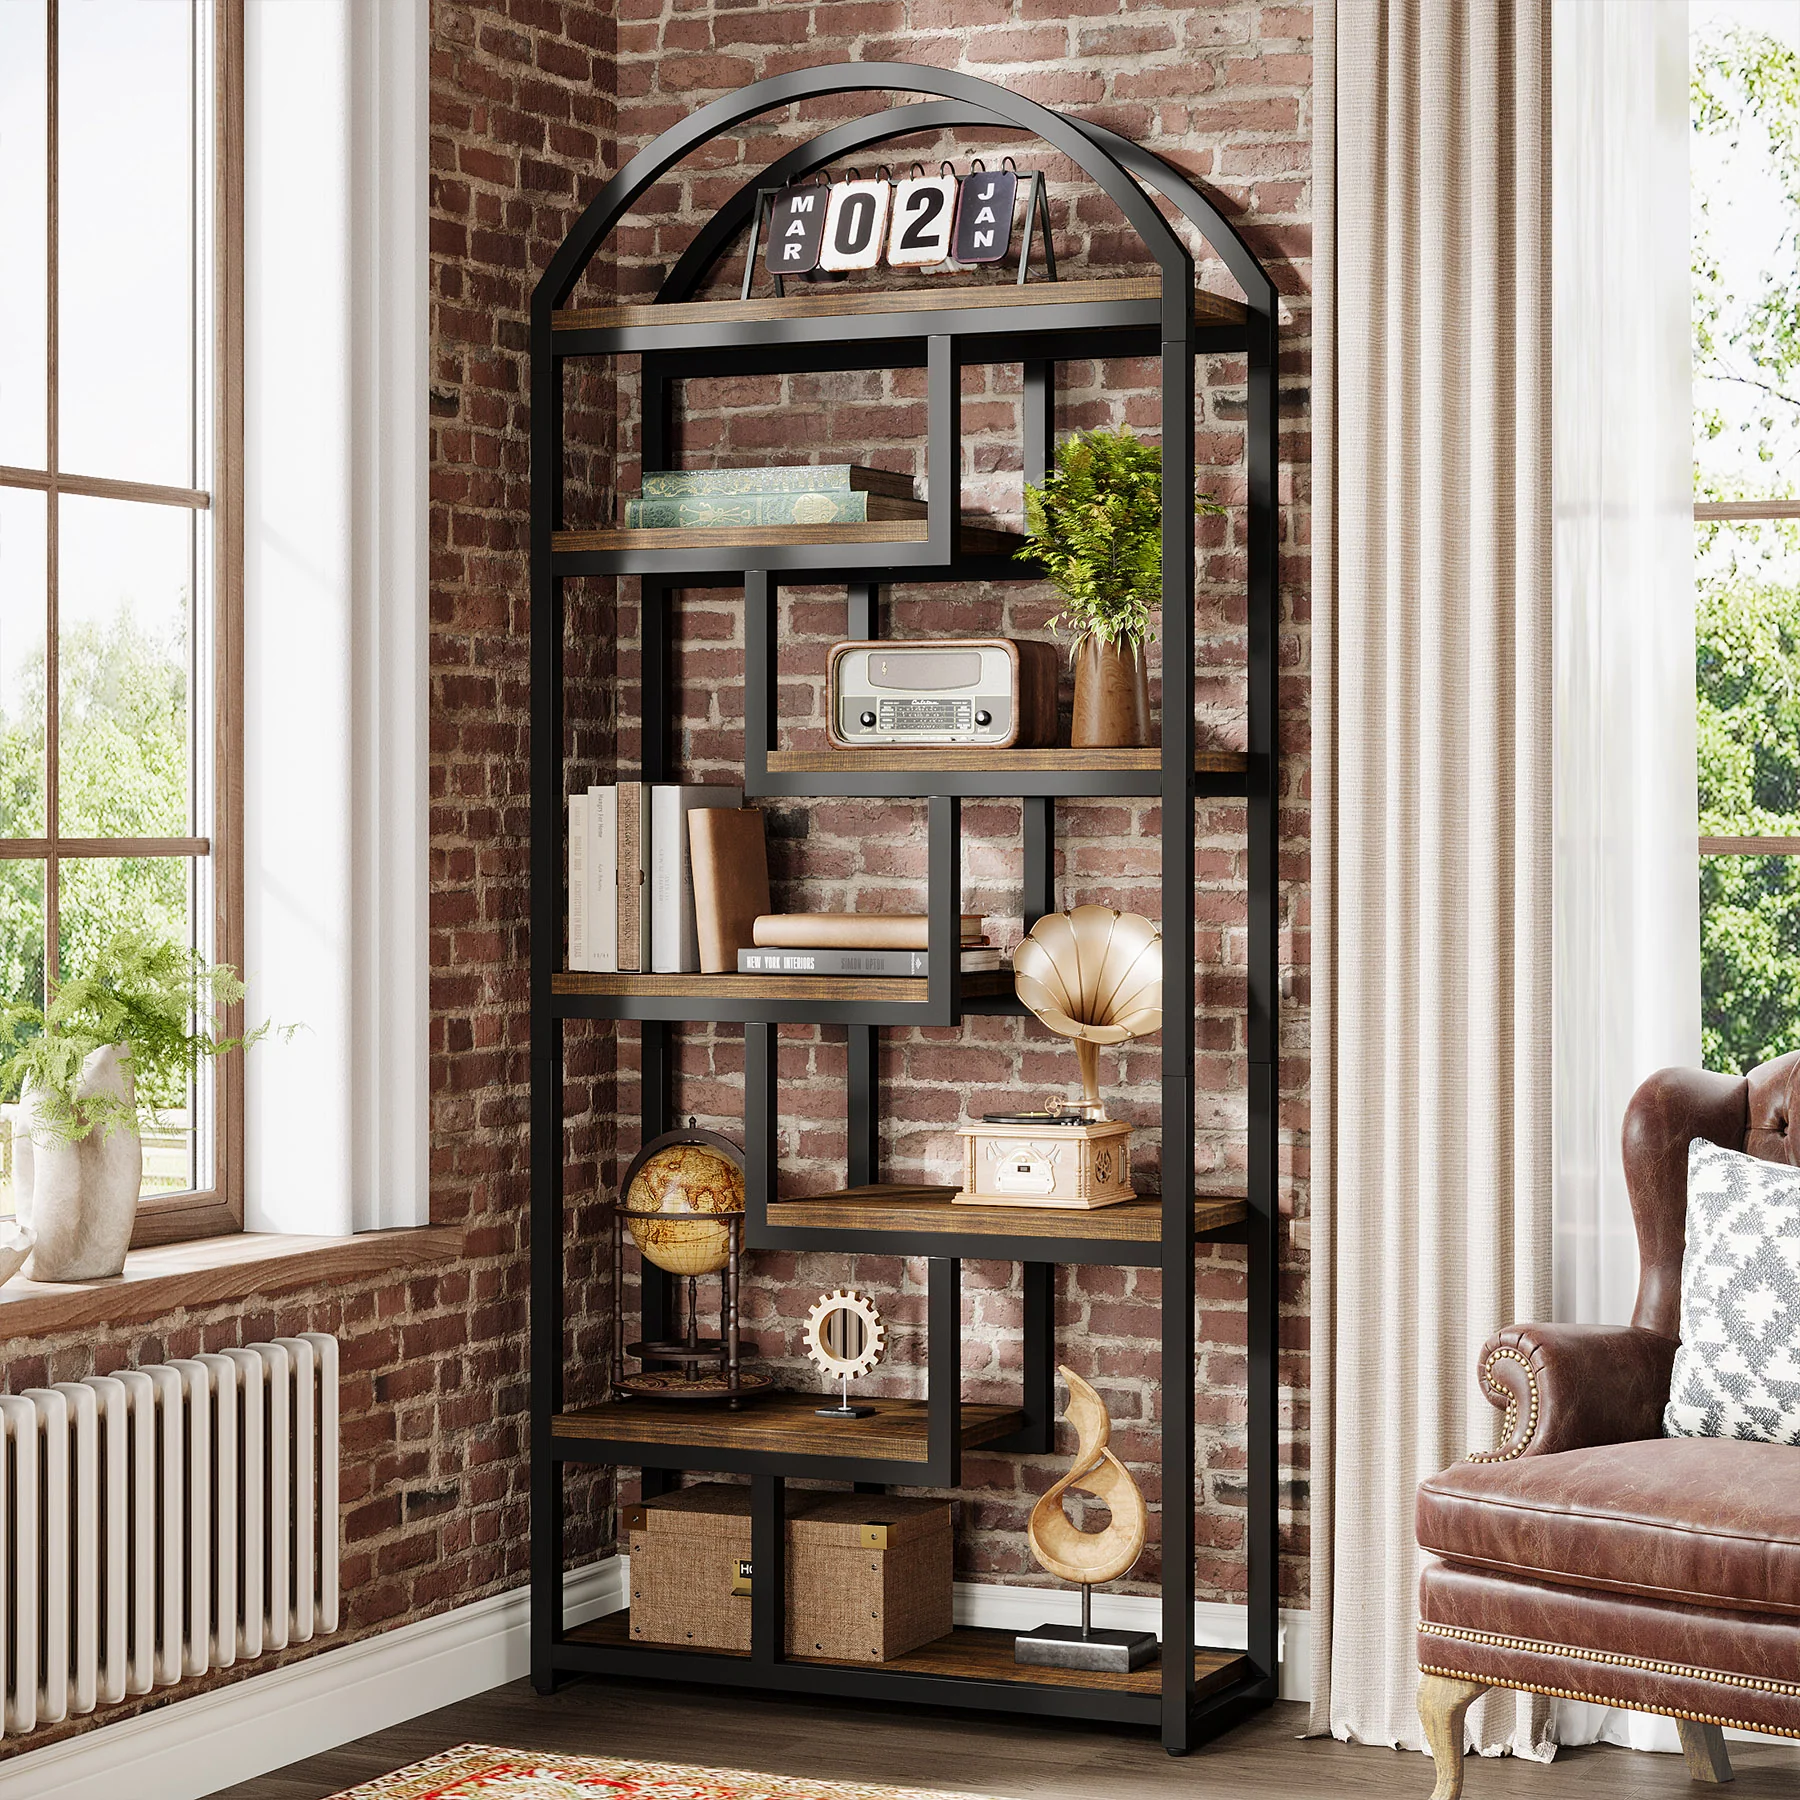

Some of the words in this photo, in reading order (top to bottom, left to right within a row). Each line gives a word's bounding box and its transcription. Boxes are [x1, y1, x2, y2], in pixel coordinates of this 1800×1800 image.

[783, 195, 815, 260] MAR
[973, 183, 995, 248] JAN
[746, 956, 761, 969] NEW
[764, 956, 780, 969] YORK
[783, 957, 815, 970] INTERIORS
